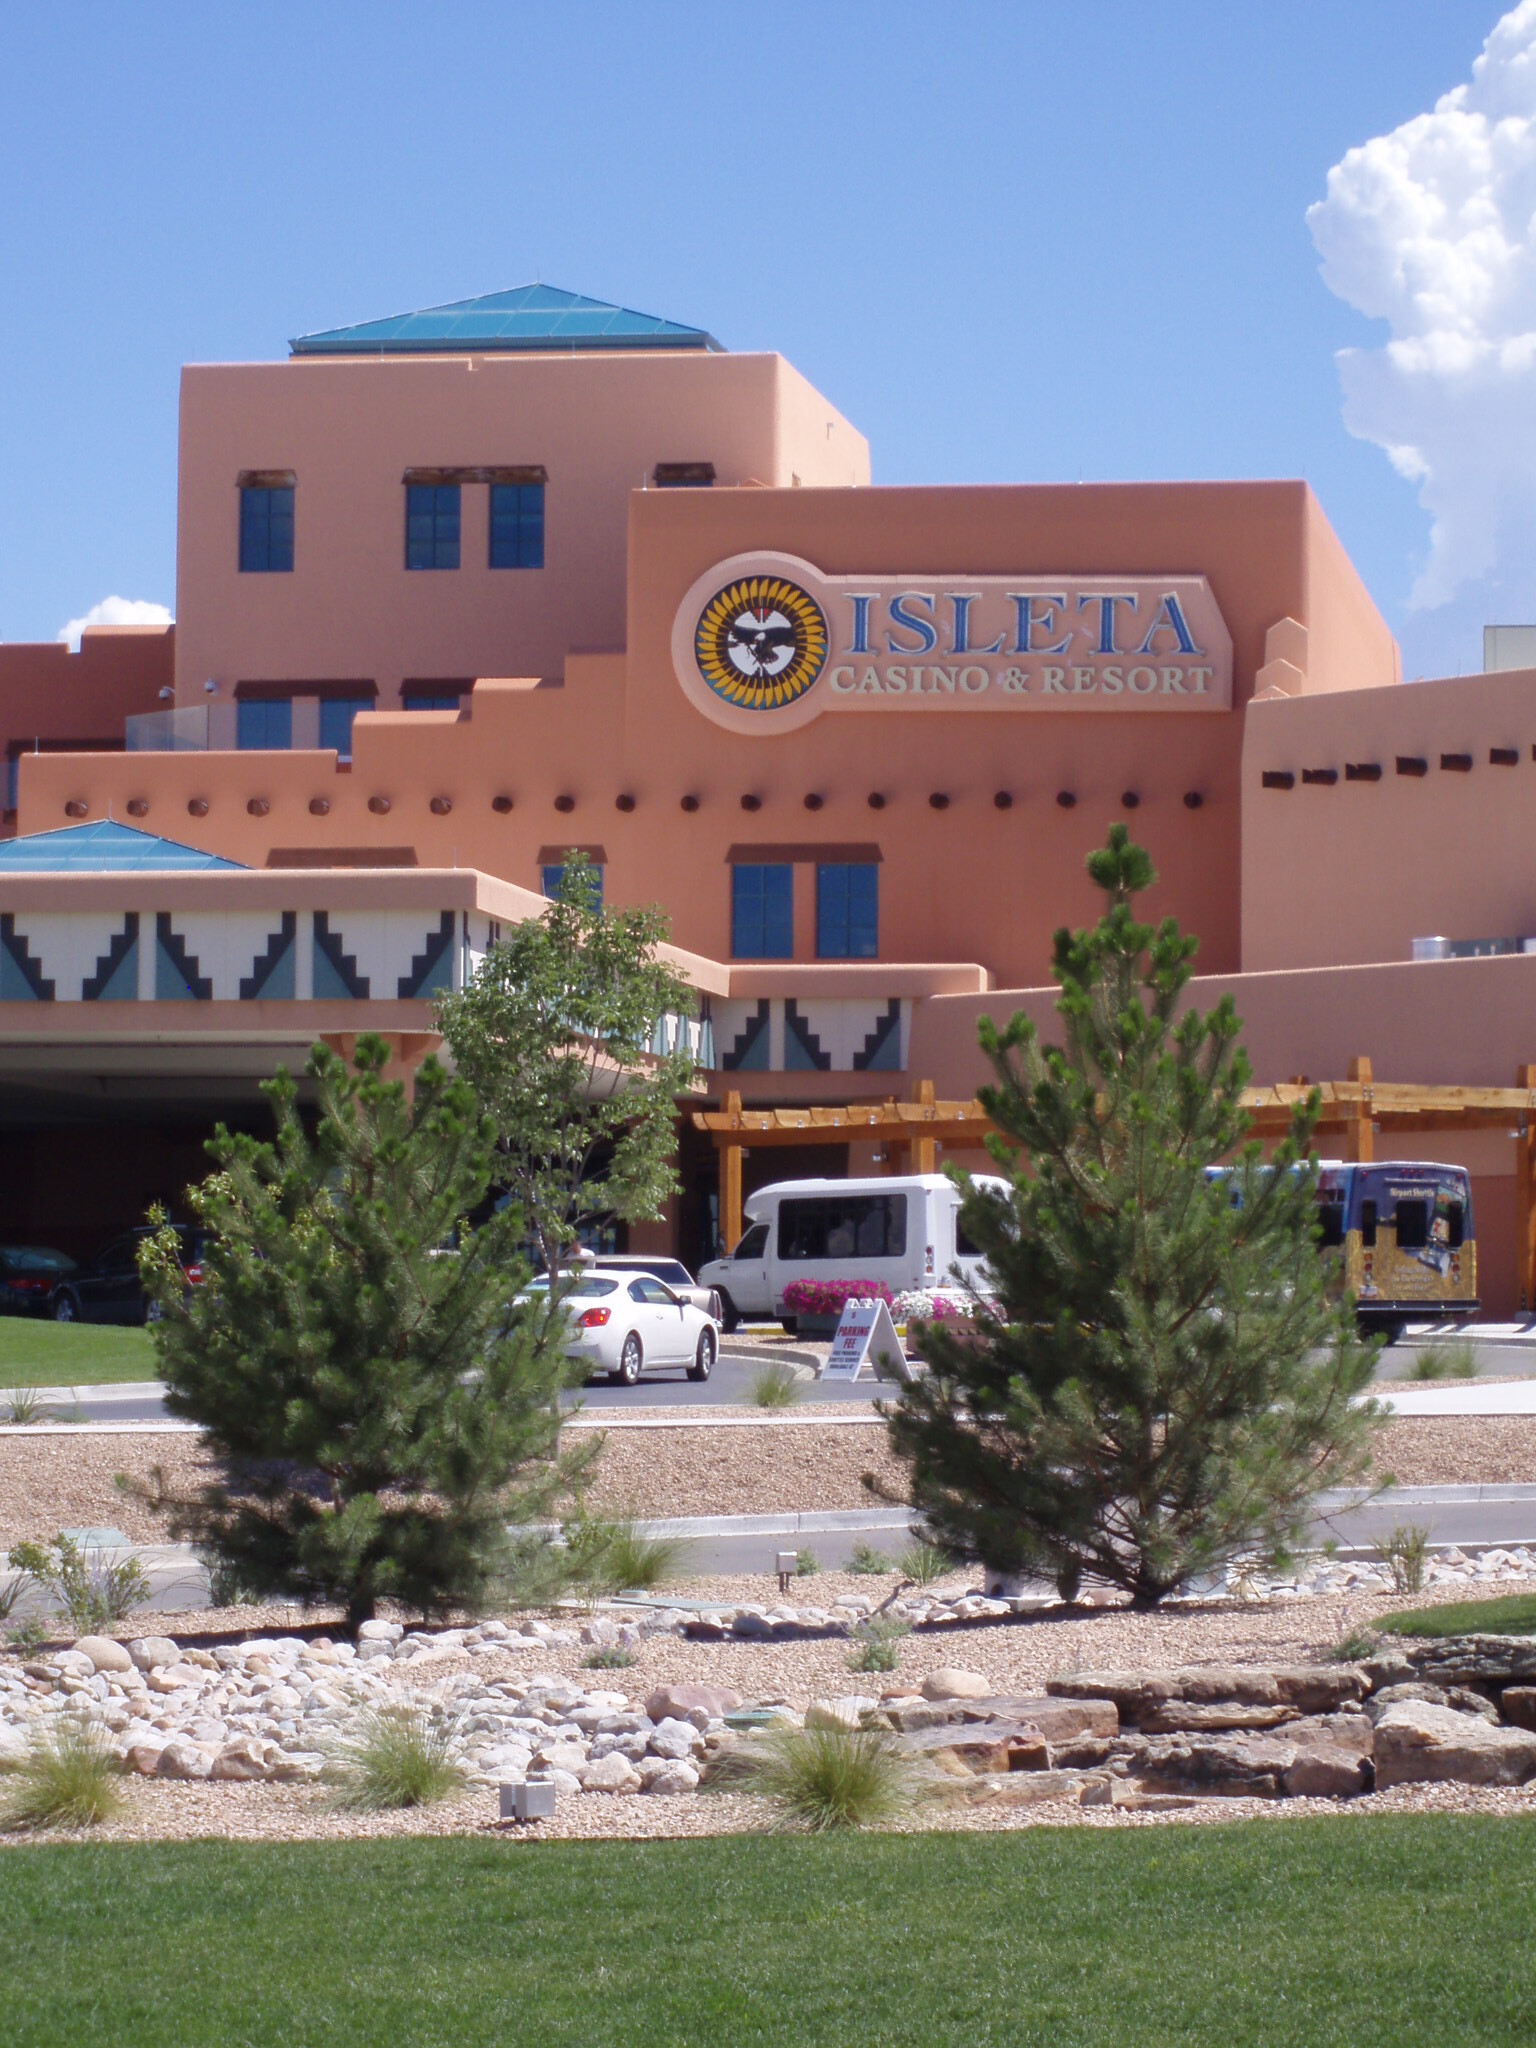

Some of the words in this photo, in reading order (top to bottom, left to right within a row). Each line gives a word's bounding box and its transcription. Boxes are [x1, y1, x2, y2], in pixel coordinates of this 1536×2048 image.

[841, 590, 1205, 657] ISLETA
[829, 665, 990, 695] CASINO
[1002, 665, 1031, 695] &
[1041, 665, 1213, 695] RESORT
[838, 1326, 870, 1337] PARKING
[843, 1338, 857, 1349] FEE
